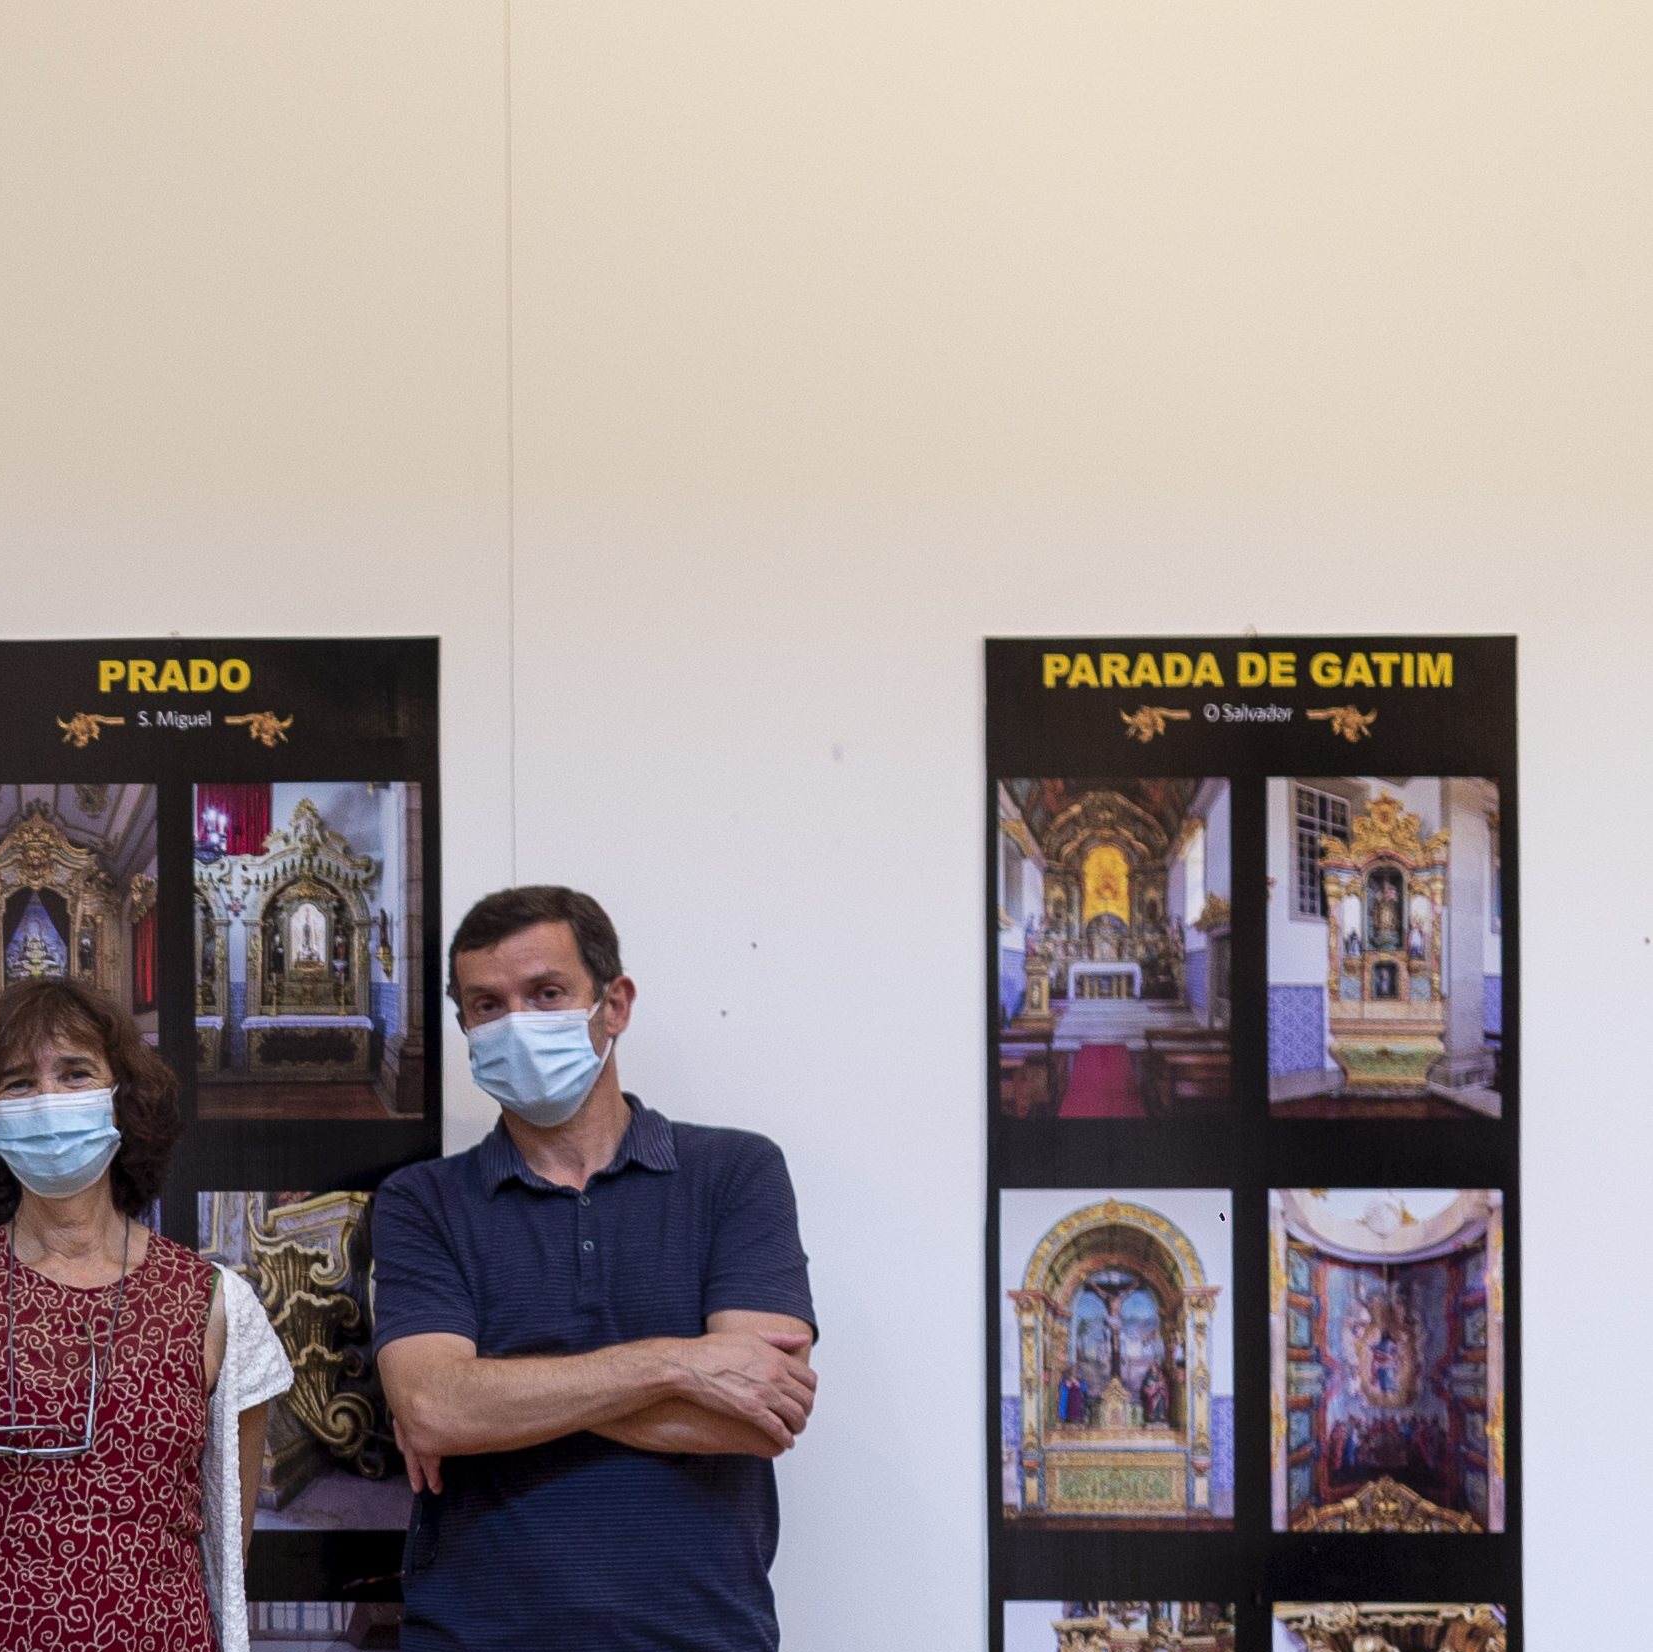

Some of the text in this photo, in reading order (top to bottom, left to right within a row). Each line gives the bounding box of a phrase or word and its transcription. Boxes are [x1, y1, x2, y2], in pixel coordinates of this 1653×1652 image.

[98, 659, 252, 693] PRADO
[1042, 652, 1454, 689] PARADA DE GATIM
[137, 709, 212, 730] S. Miguel
[1222, 703, 1293, 722] Salvador
